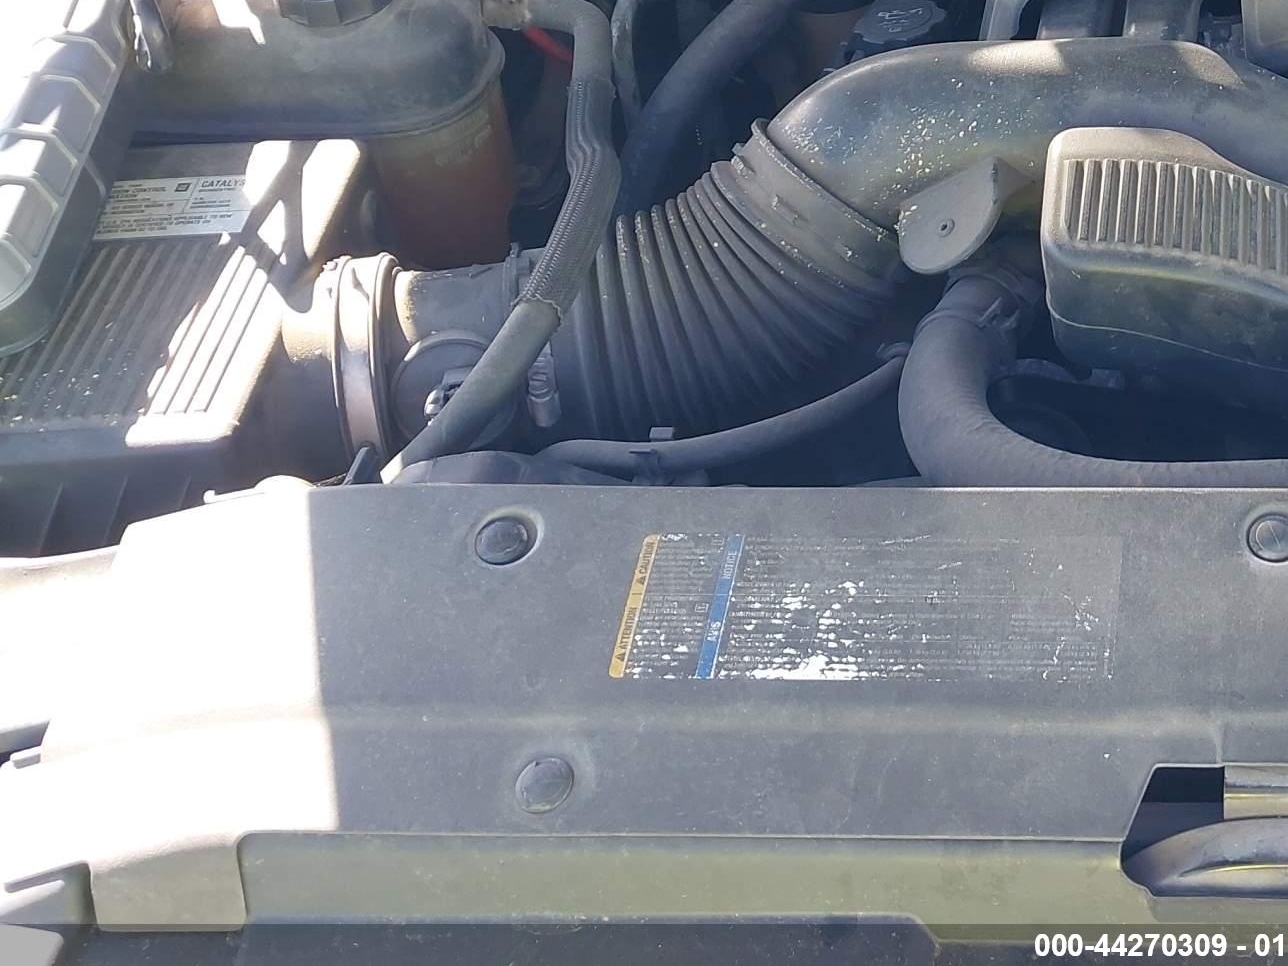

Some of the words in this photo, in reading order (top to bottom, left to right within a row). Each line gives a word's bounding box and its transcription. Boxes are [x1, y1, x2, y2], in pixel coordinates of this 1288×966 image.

[200, 179, 247, 189] CATALYS
[722, 550, 737, 580] NOTICE
[621, 607, 638, 650] ATTENTION
[638, 541, 656, 575] CAUTION
